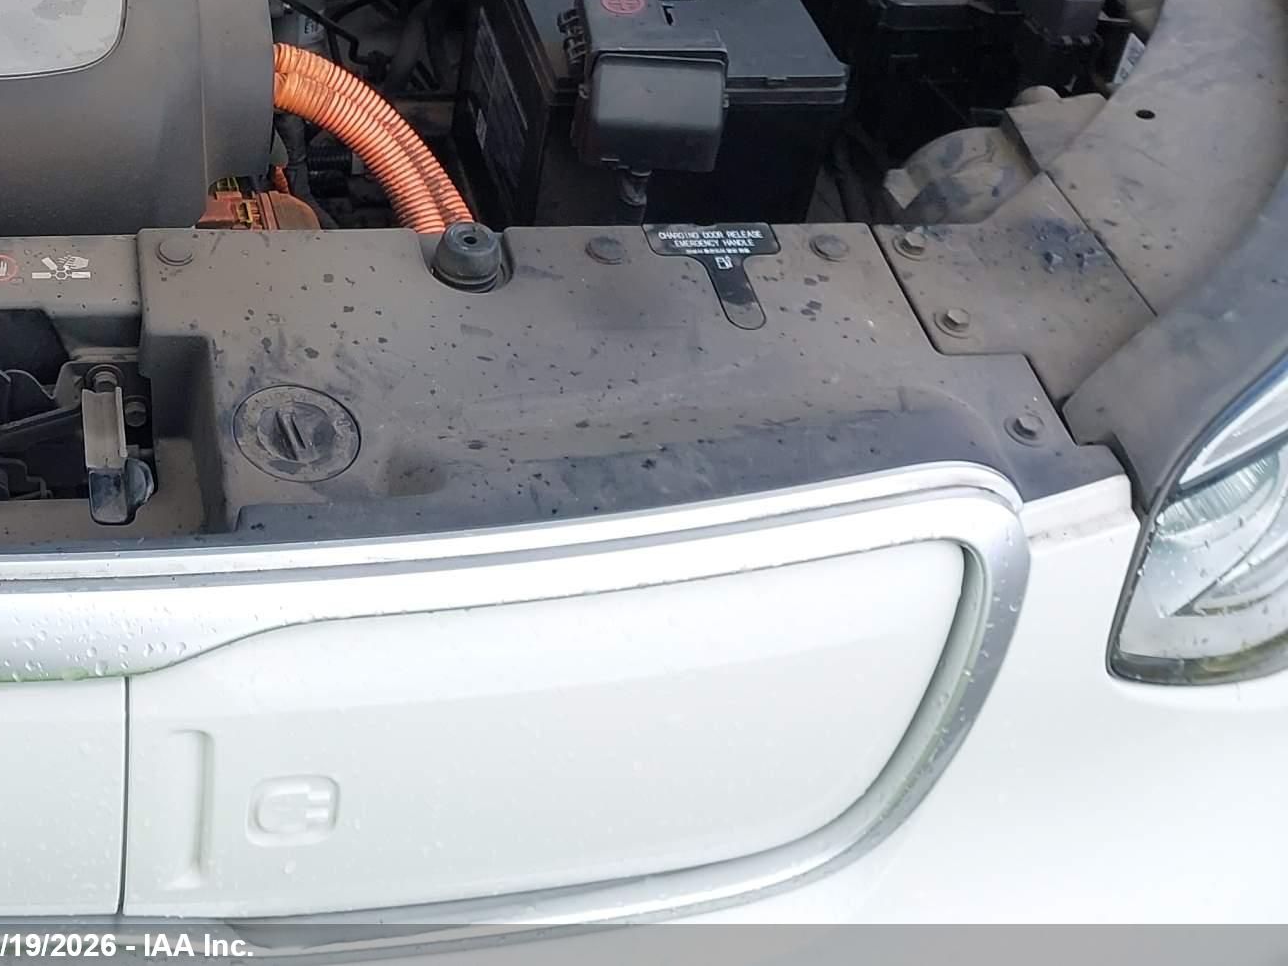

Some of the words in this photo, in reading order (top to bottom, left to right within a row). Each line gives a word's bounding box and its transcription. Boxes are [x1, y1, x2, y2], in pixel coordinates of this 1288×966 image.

[658, 231, 700, 239] CHARGING
[702, 231, 724, 239] DOOR
[726, 230, 763, 239] RELEASE
[674, 239, 720, 247] EMERGENCY
[722, 239, 755, 247] HANDLE
